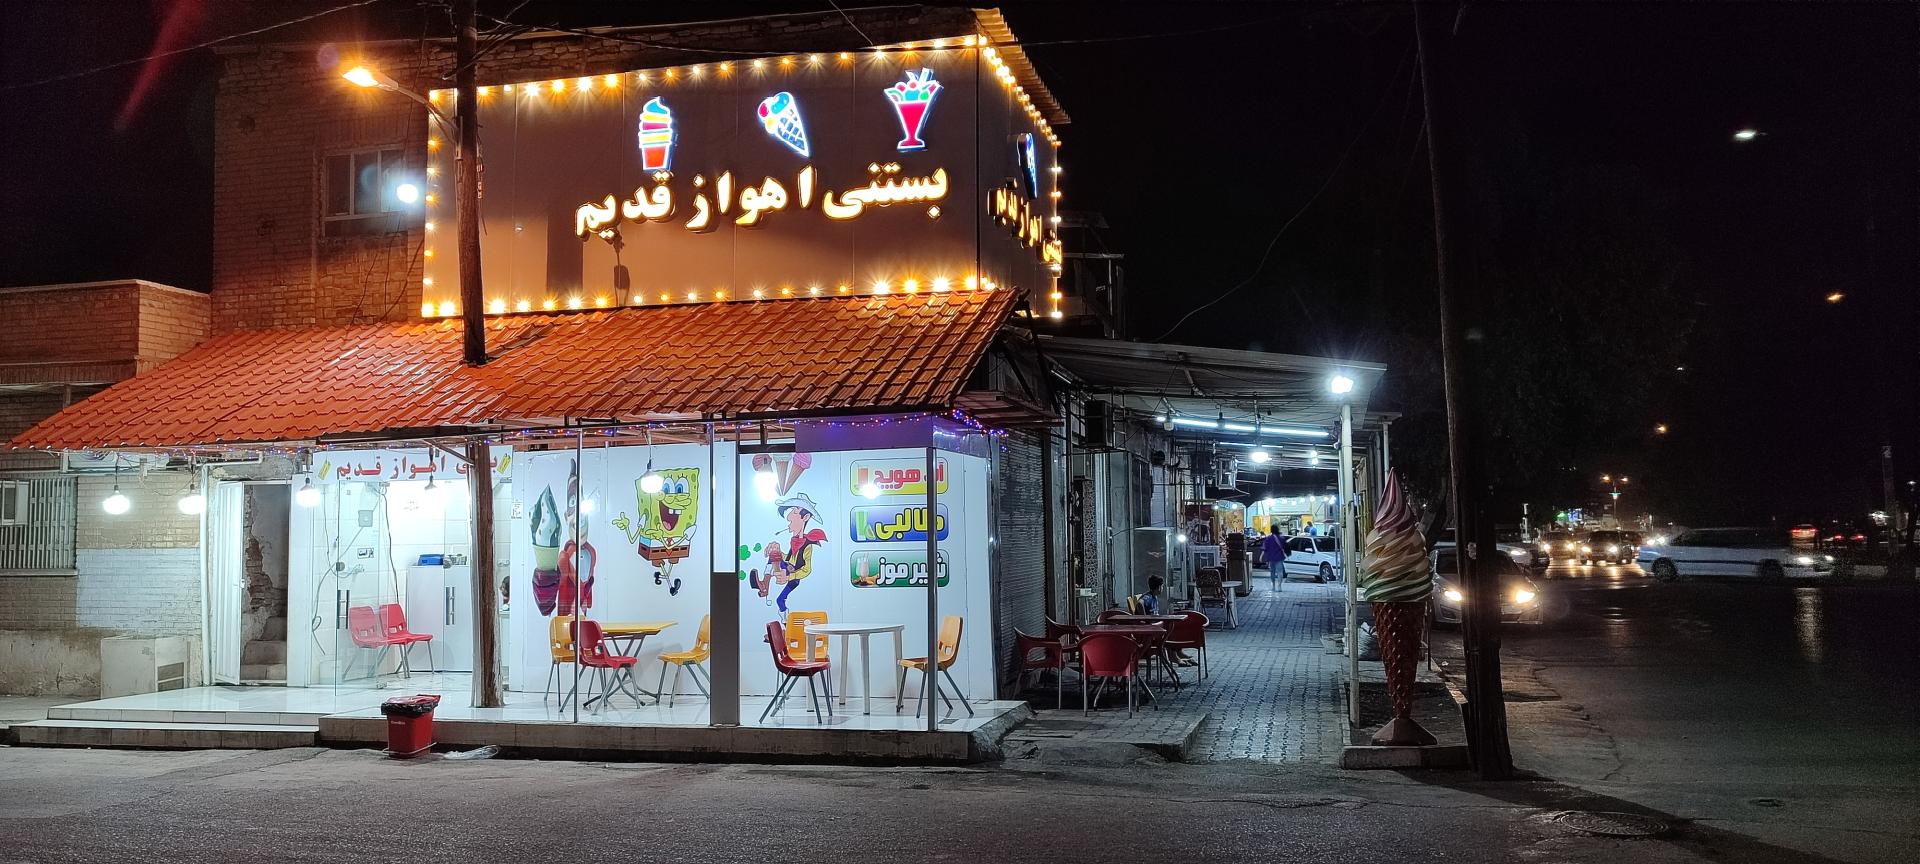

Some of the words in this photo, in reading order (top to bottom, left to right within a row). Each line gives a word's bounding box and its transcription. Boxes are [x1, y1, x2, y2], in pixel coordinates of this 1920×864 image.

[576, 170, 675, 240] قدیم
[823, 162, 949, 221] بستنی
[337, 456, 381, 480] قدیم
[876, 556, 909, 585] موز
